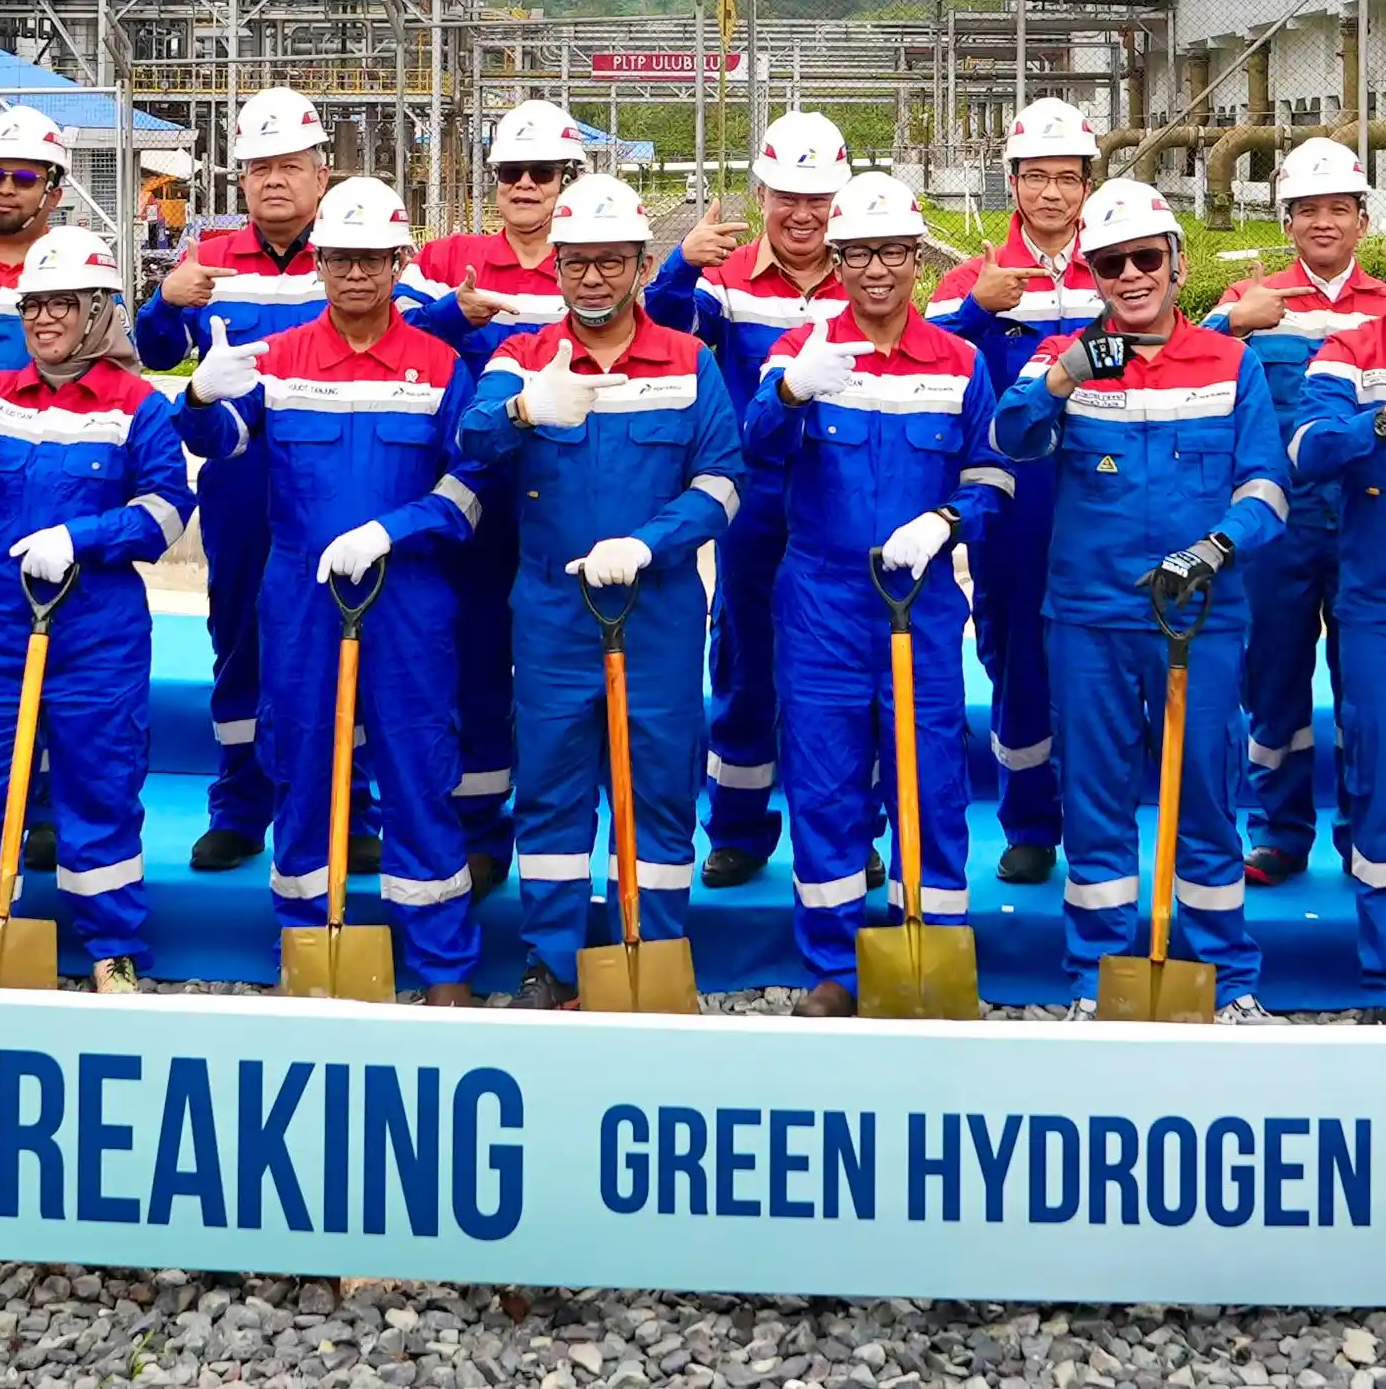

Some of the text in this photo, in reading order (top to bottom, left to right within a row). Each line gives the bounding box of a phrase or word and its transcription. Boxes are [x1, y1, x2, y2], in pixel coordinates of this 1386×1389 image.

[613, 55, 646, 70] PLTP
[599, 1103, 876, 1221] GREEN
[907, 1111, 1372, 1228] HYDROGEN
